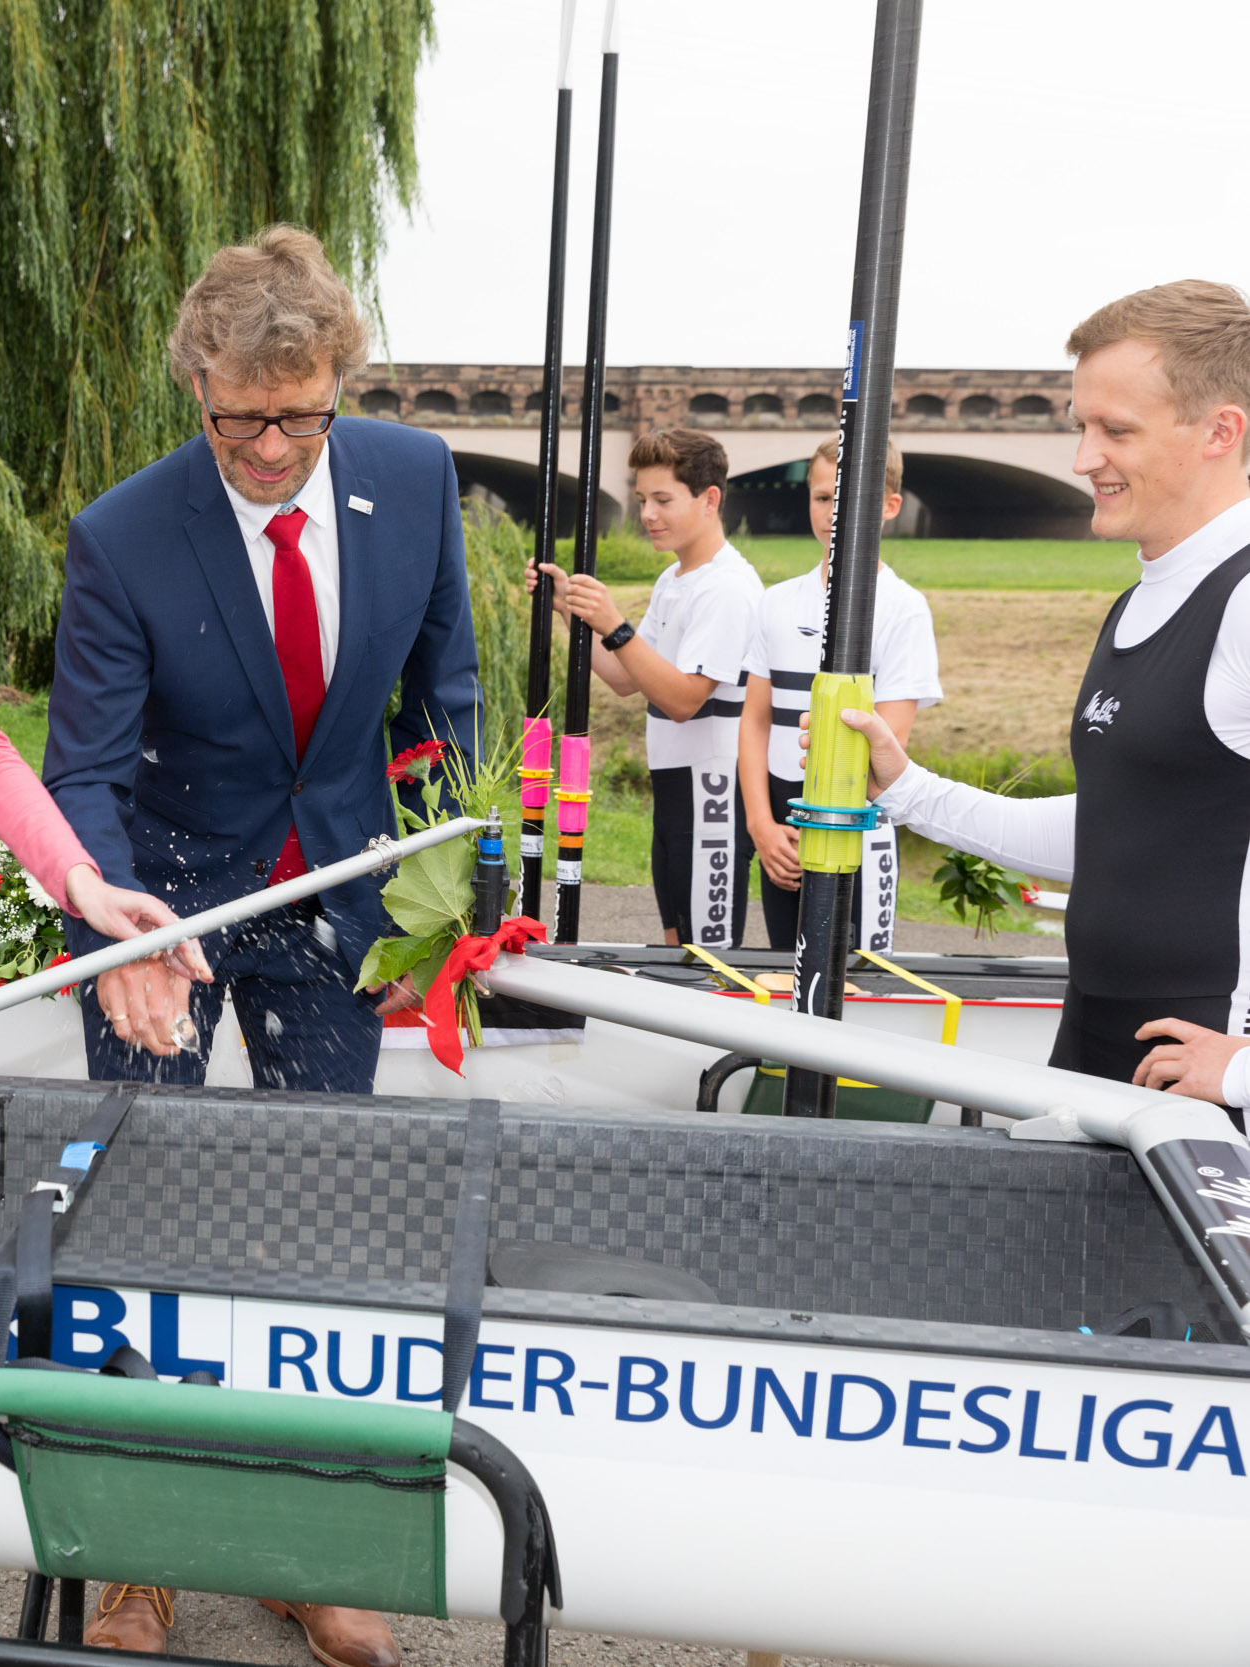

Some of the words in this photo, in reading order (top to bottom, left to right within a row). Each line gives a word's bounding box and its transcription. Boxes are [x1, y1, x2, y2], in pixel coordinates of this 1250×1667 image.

[700, 772, 729, 823] RC
[700, 840, 729, 944] Bessel
[870, 841, 894, 952] Bessel
[268, 1326, 1247, 1477] RUDER-BUNDESLIGA
